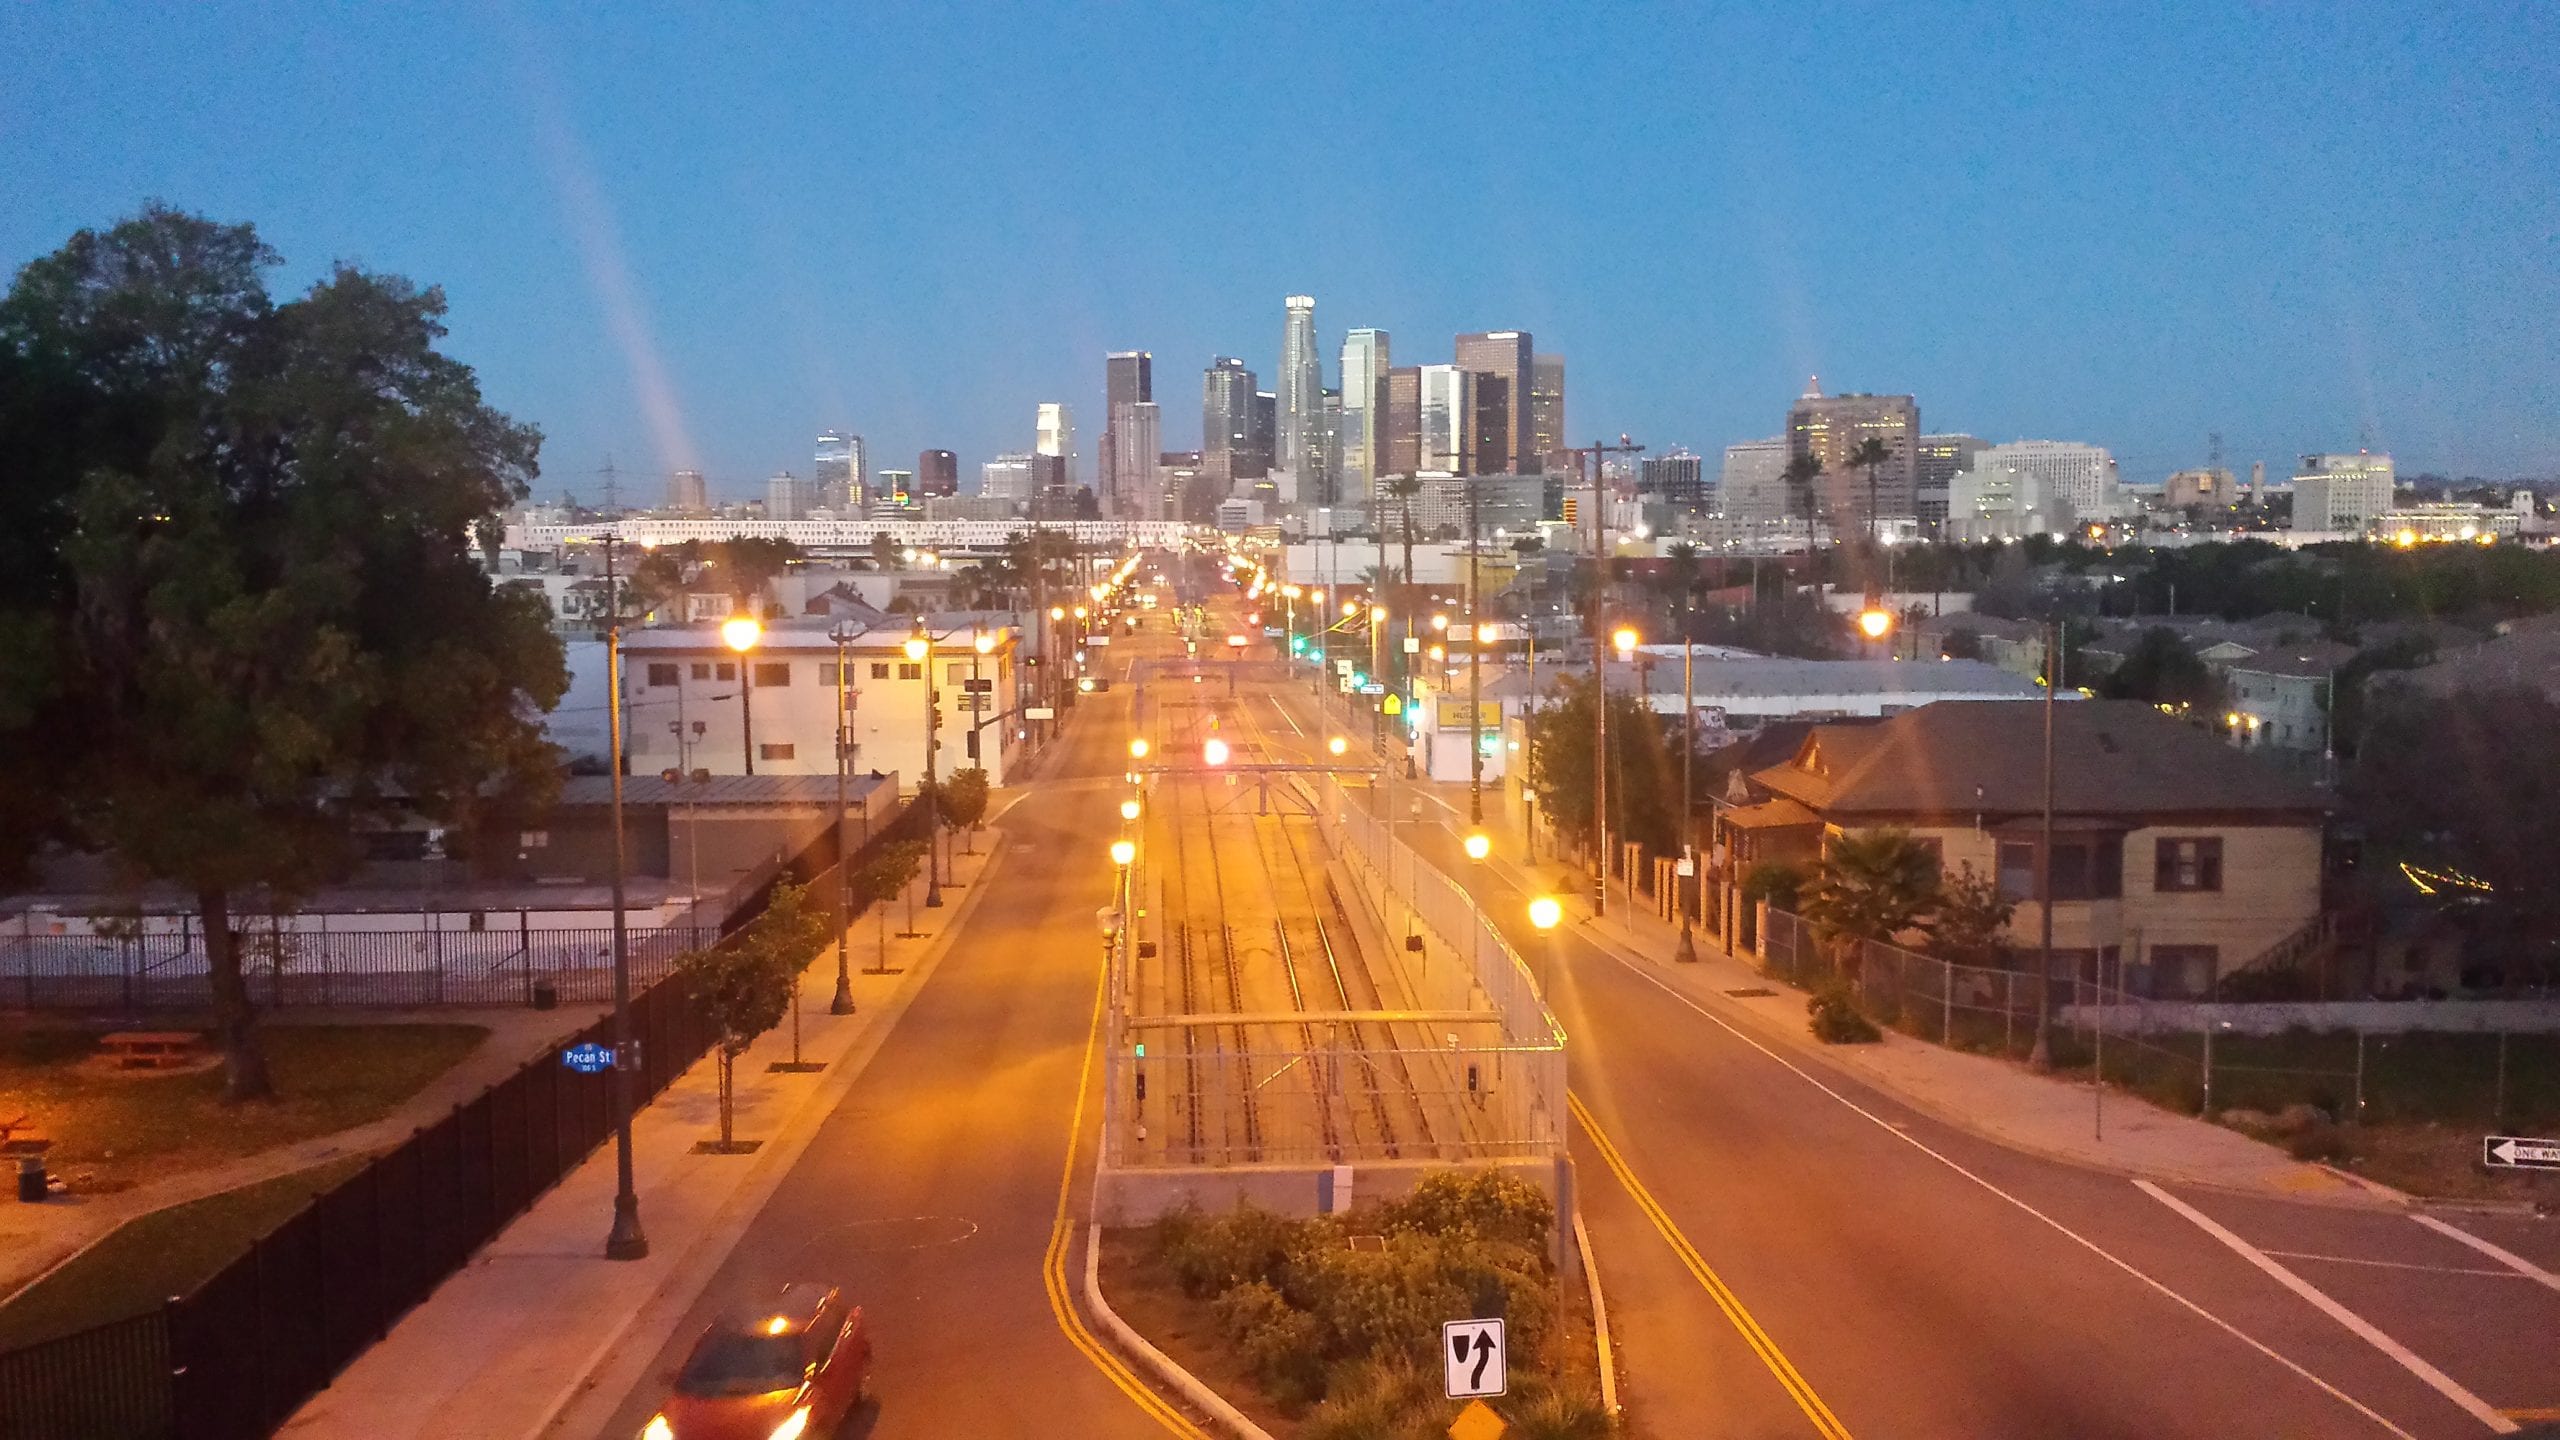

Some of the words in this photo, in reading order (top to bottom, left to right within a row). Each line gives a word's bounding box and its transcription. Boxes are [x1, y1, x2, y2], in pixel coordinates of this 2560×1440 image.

[566, 1051, 595, 1063] Pecan
[599, 1051, 610, 1063] St
[2514, 1147, 2537, 1158] ONE
[2542, 1150, 2560, 1159] WA
